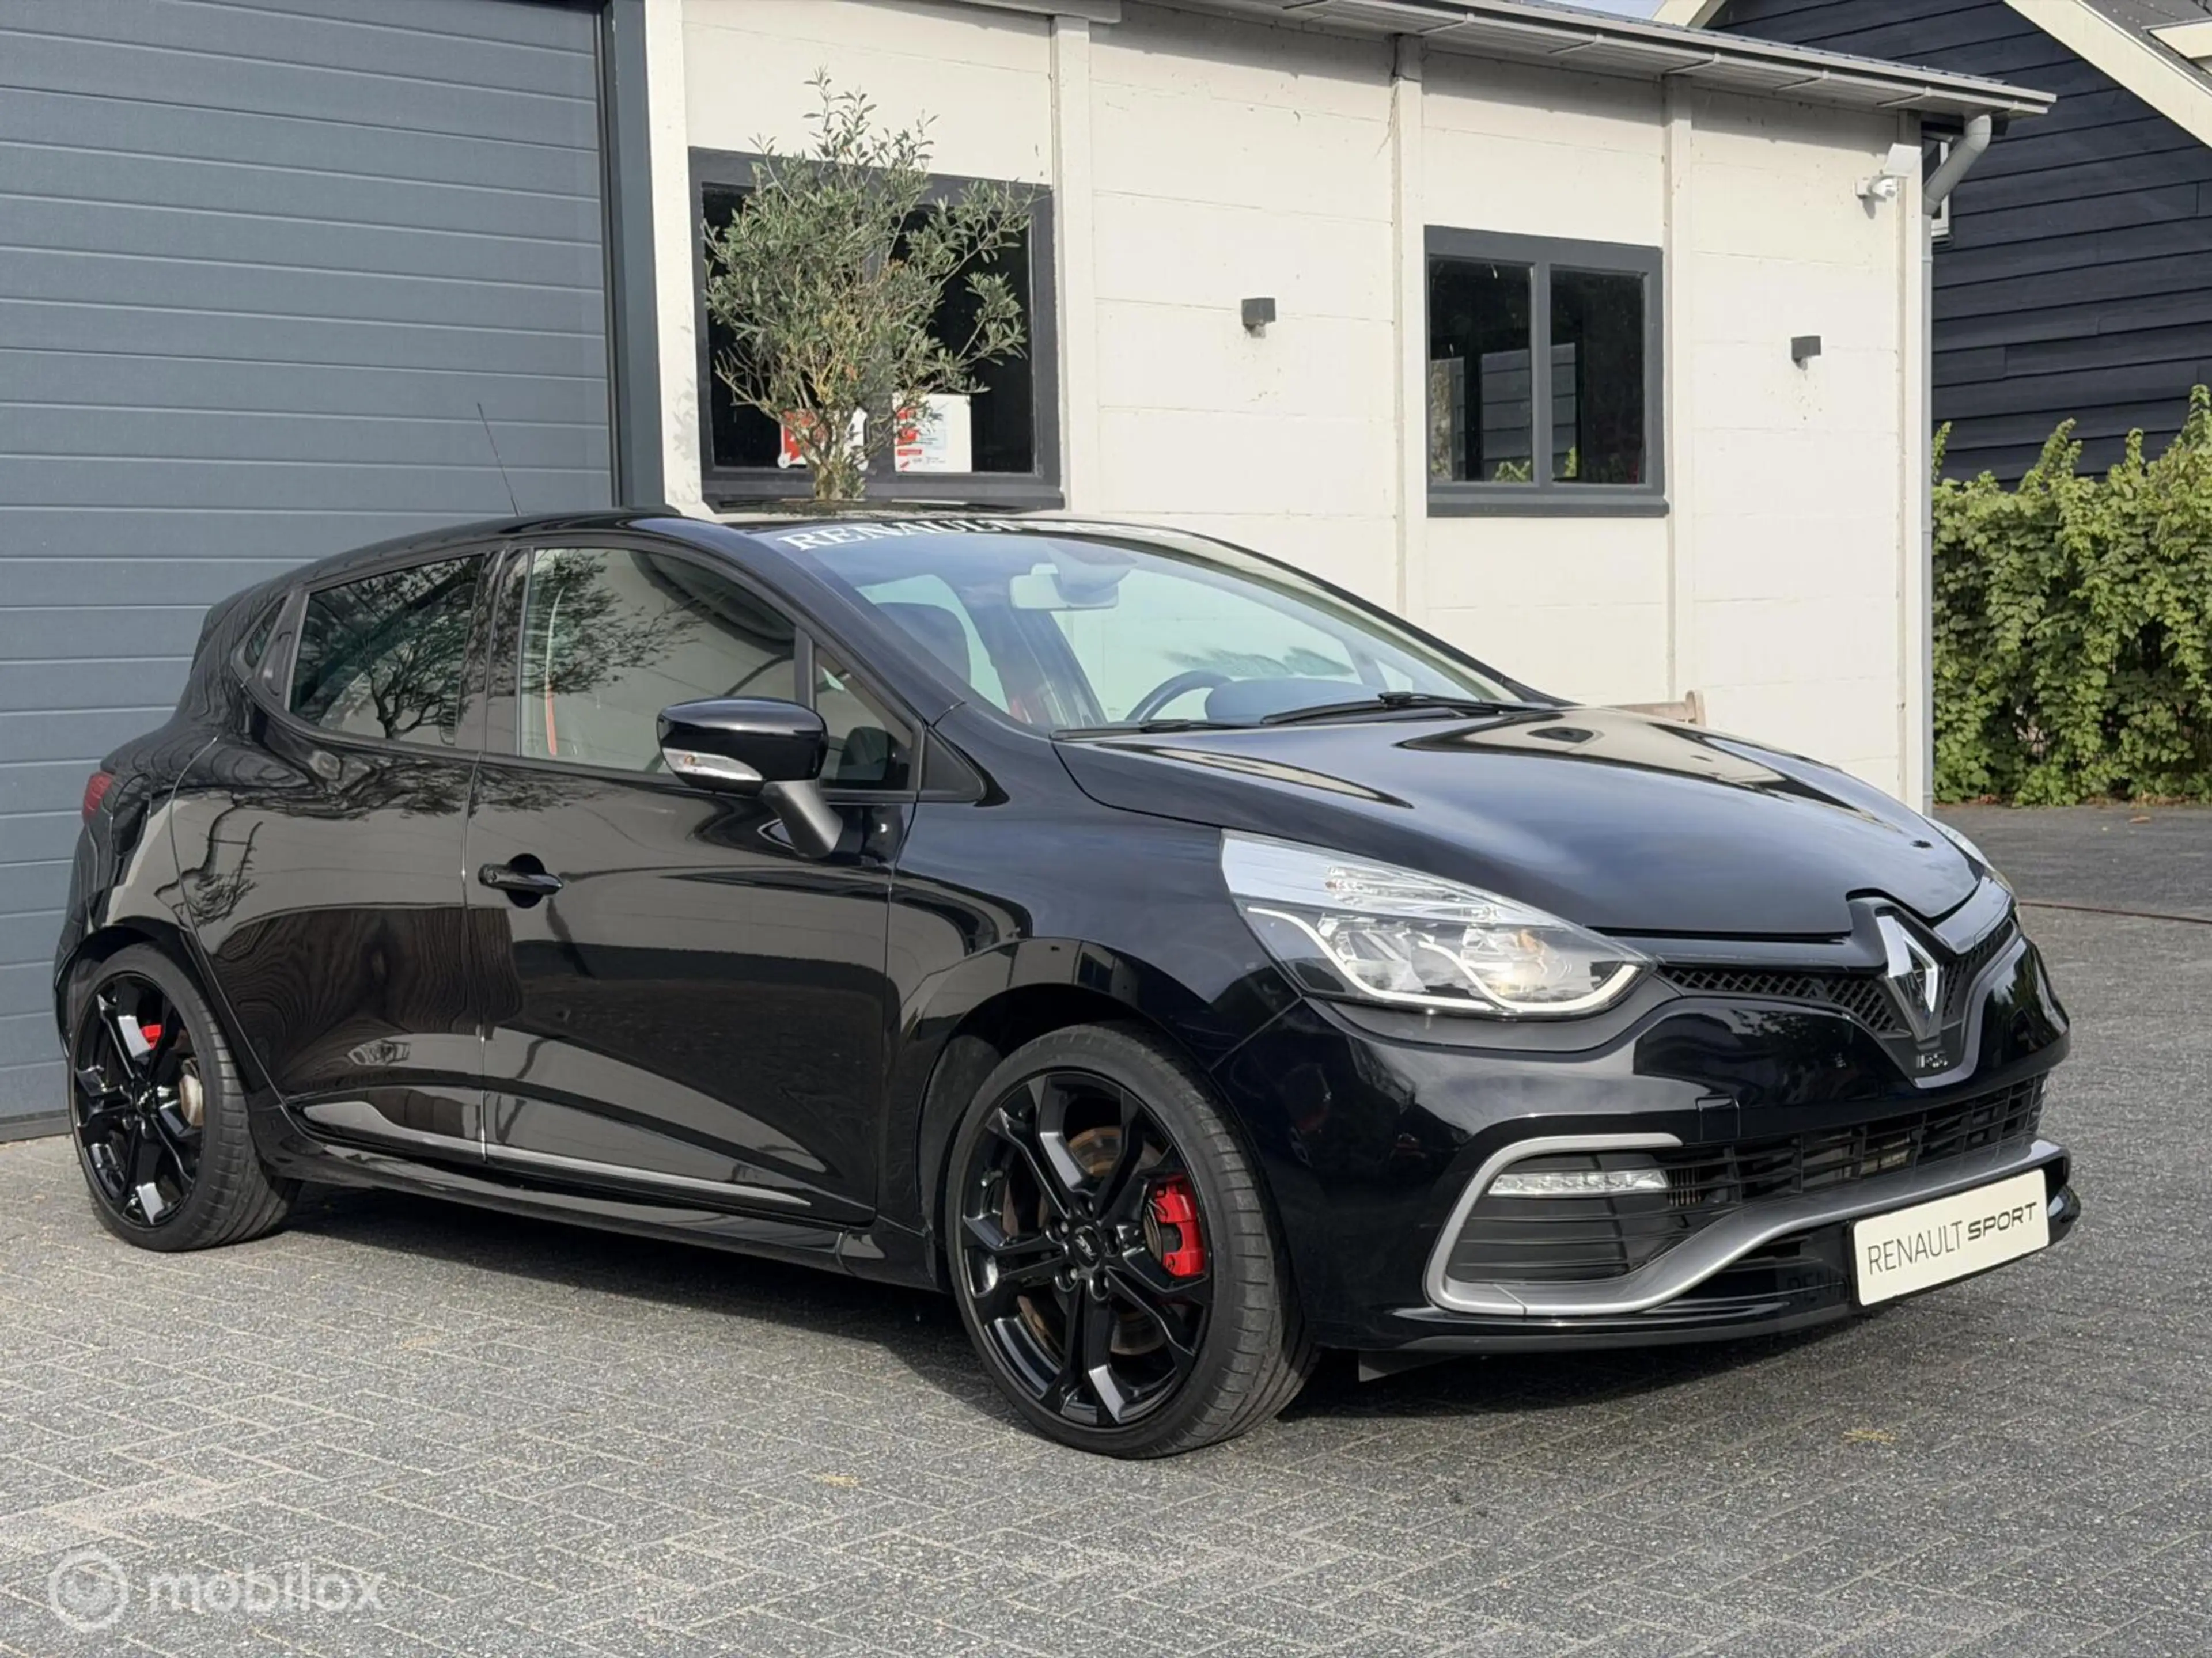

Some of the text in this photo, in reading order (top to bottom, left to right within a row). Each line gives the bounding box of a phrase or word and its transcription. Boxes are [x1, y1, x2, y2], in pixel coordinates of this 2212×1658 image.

[777, 519, 1021, 551] RENAULT
[1867, 1202, 2037, 1274] RENAULT SPORT
